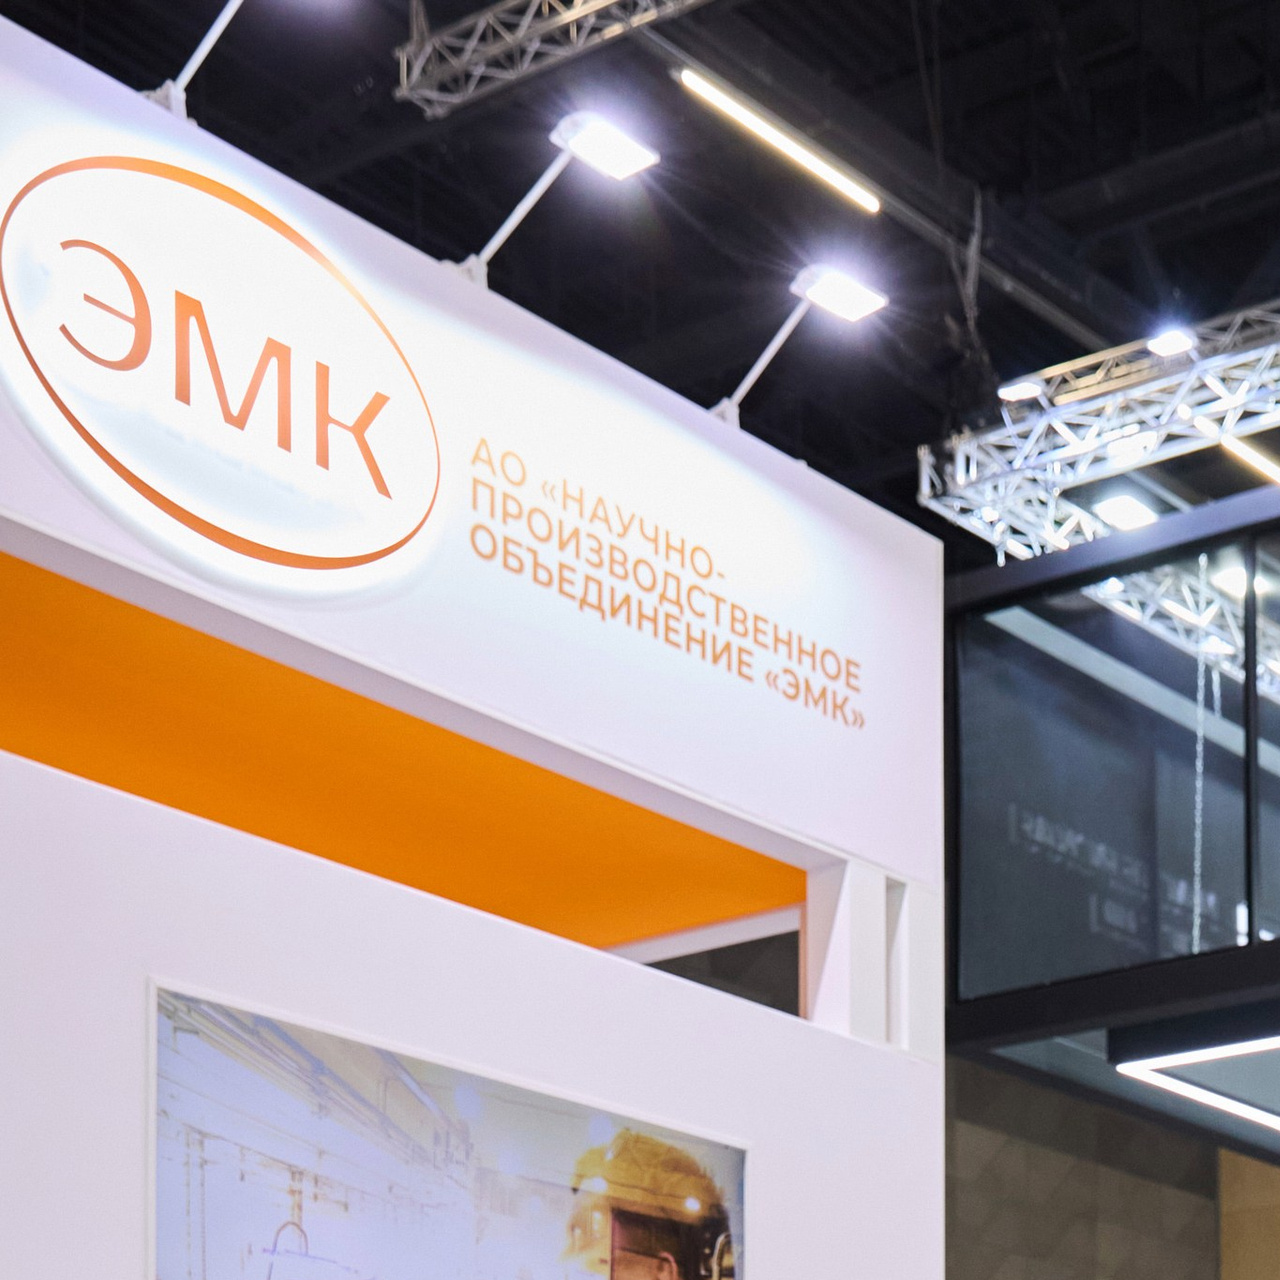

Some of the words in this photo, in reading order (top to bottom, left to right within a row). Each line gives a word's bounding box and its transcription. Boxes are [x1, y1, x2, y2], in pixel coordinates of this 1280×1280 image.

[59, 238, 393, 500] ЭМК
[472, 438, 528, 487] АО
[541, 476, 726, 583] «НАУЧНО-
[472, 476, 862, 694] ПРОИЗВОДСТВЕННОЕ
[471, 522, 755, 684] ОБЪЕДИНЕНИЕ
[765, 666, 867, 731] «ЭМК»
